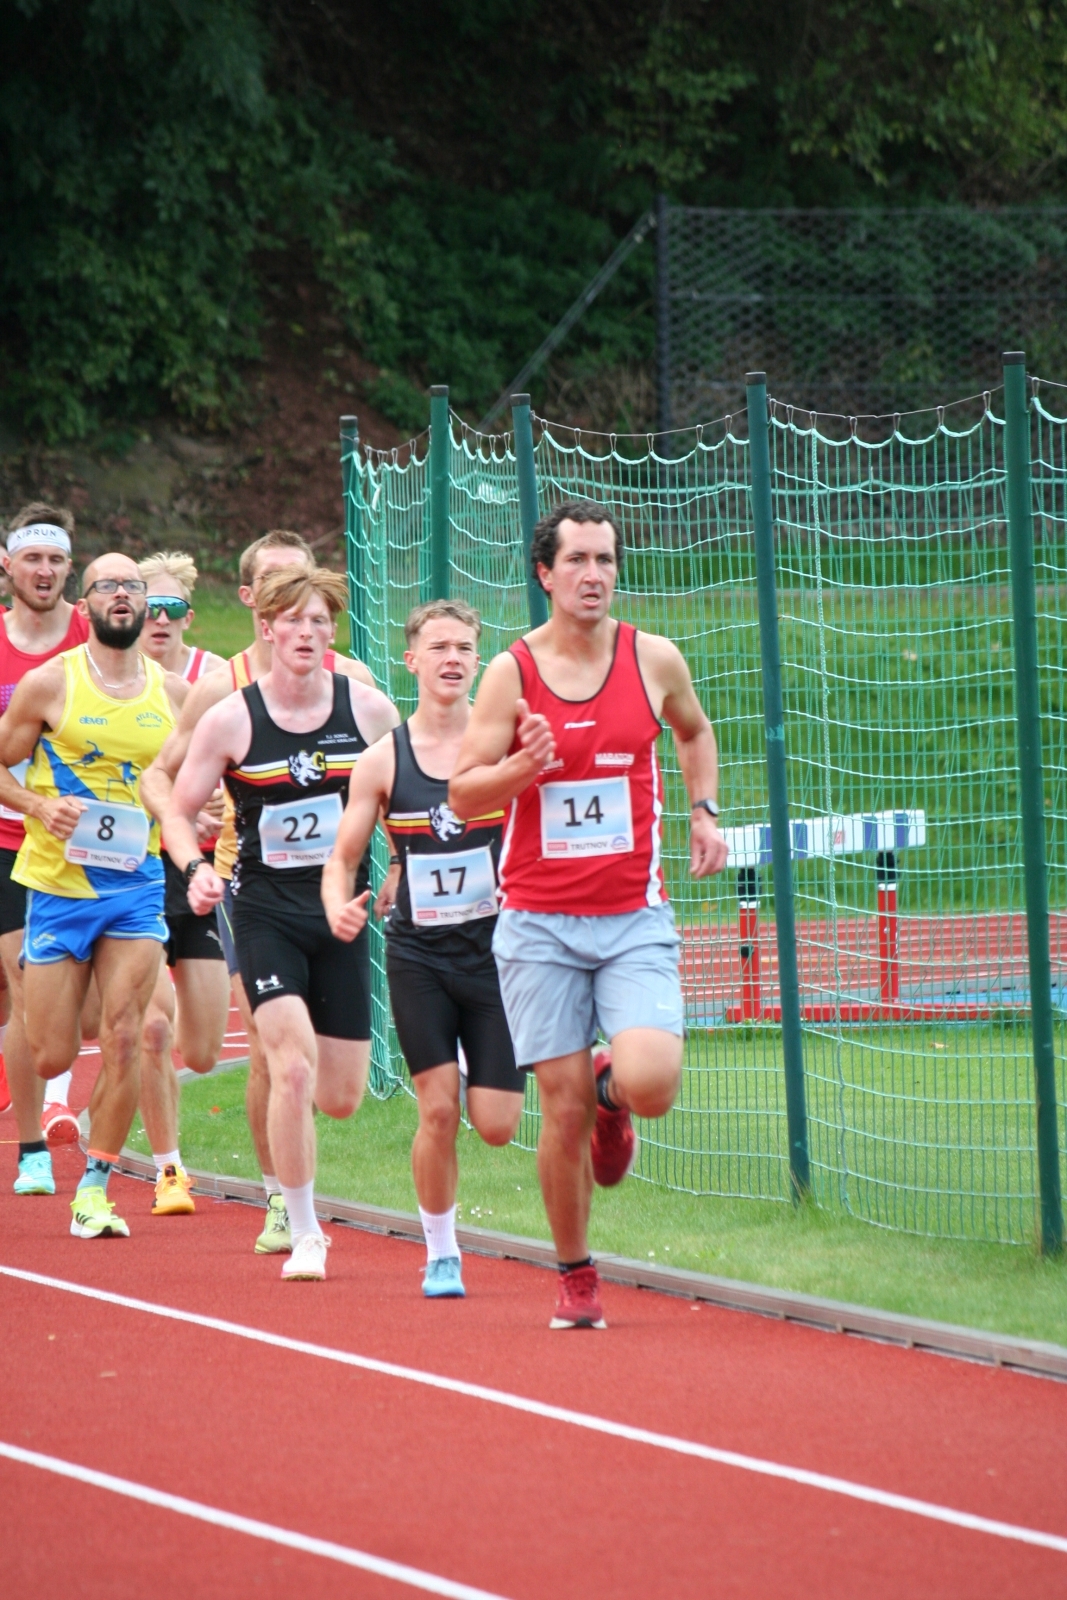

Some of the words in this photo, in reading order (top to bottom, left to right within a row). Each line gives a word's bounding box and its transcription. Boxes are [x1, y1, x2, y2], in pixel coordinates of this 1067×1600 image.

[563, 795, 604, 827] 14
[97, 815, 115, 841] 8
[283, 812, 321, 842] 22
[570, 841, 608, 851] TRUTNOV
[90, 853, 122, 863] TRUTNOV
[291, 852, 324, 861] TRUTNOV
[430, 866, 466, 897] 17
[439, 908, 473, 918] TRUTNOV
